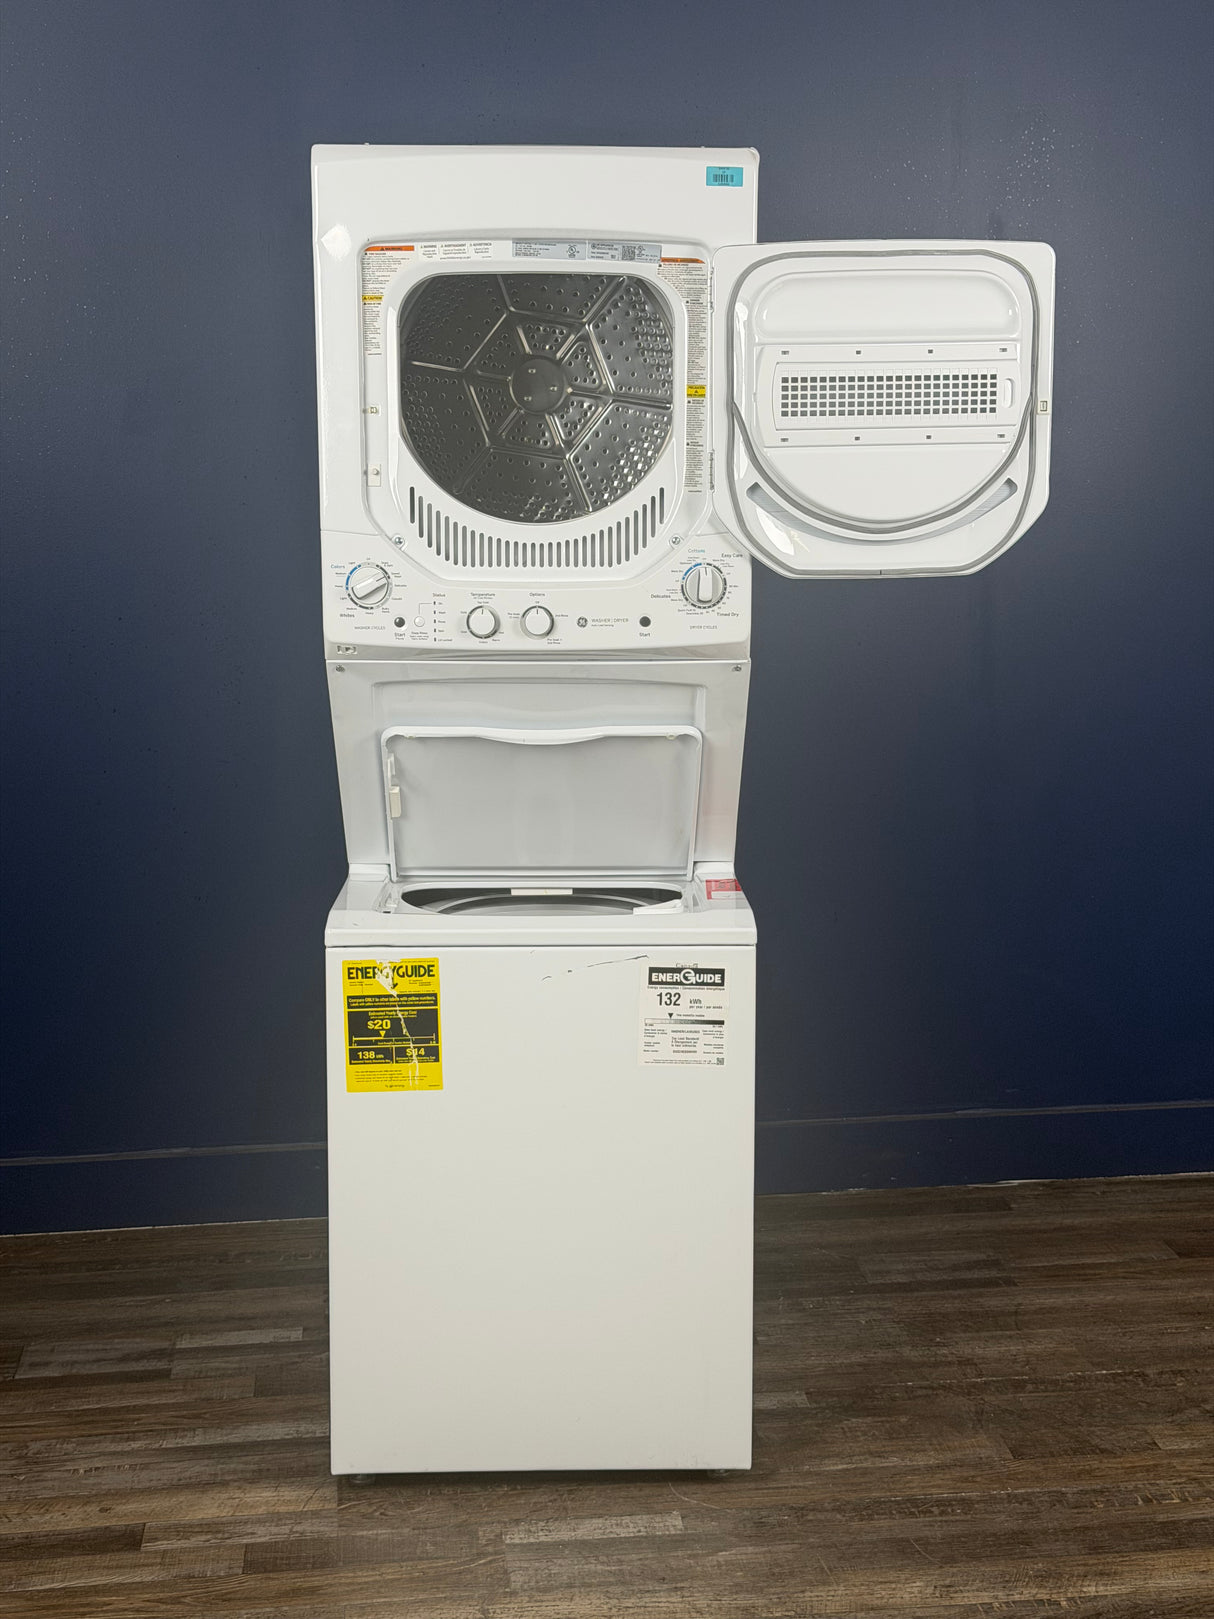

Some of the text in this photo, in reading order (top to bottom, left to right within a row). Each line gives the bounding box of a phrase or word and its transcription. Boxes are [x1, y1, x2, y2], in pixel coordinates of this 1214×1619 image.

[651, 968, 722, 984] ENERGUIDE
[657, 992, 681, 1006] 132
[368, 1020, 391, 1029] $20
[357, 1051, 375, 1059] 138
